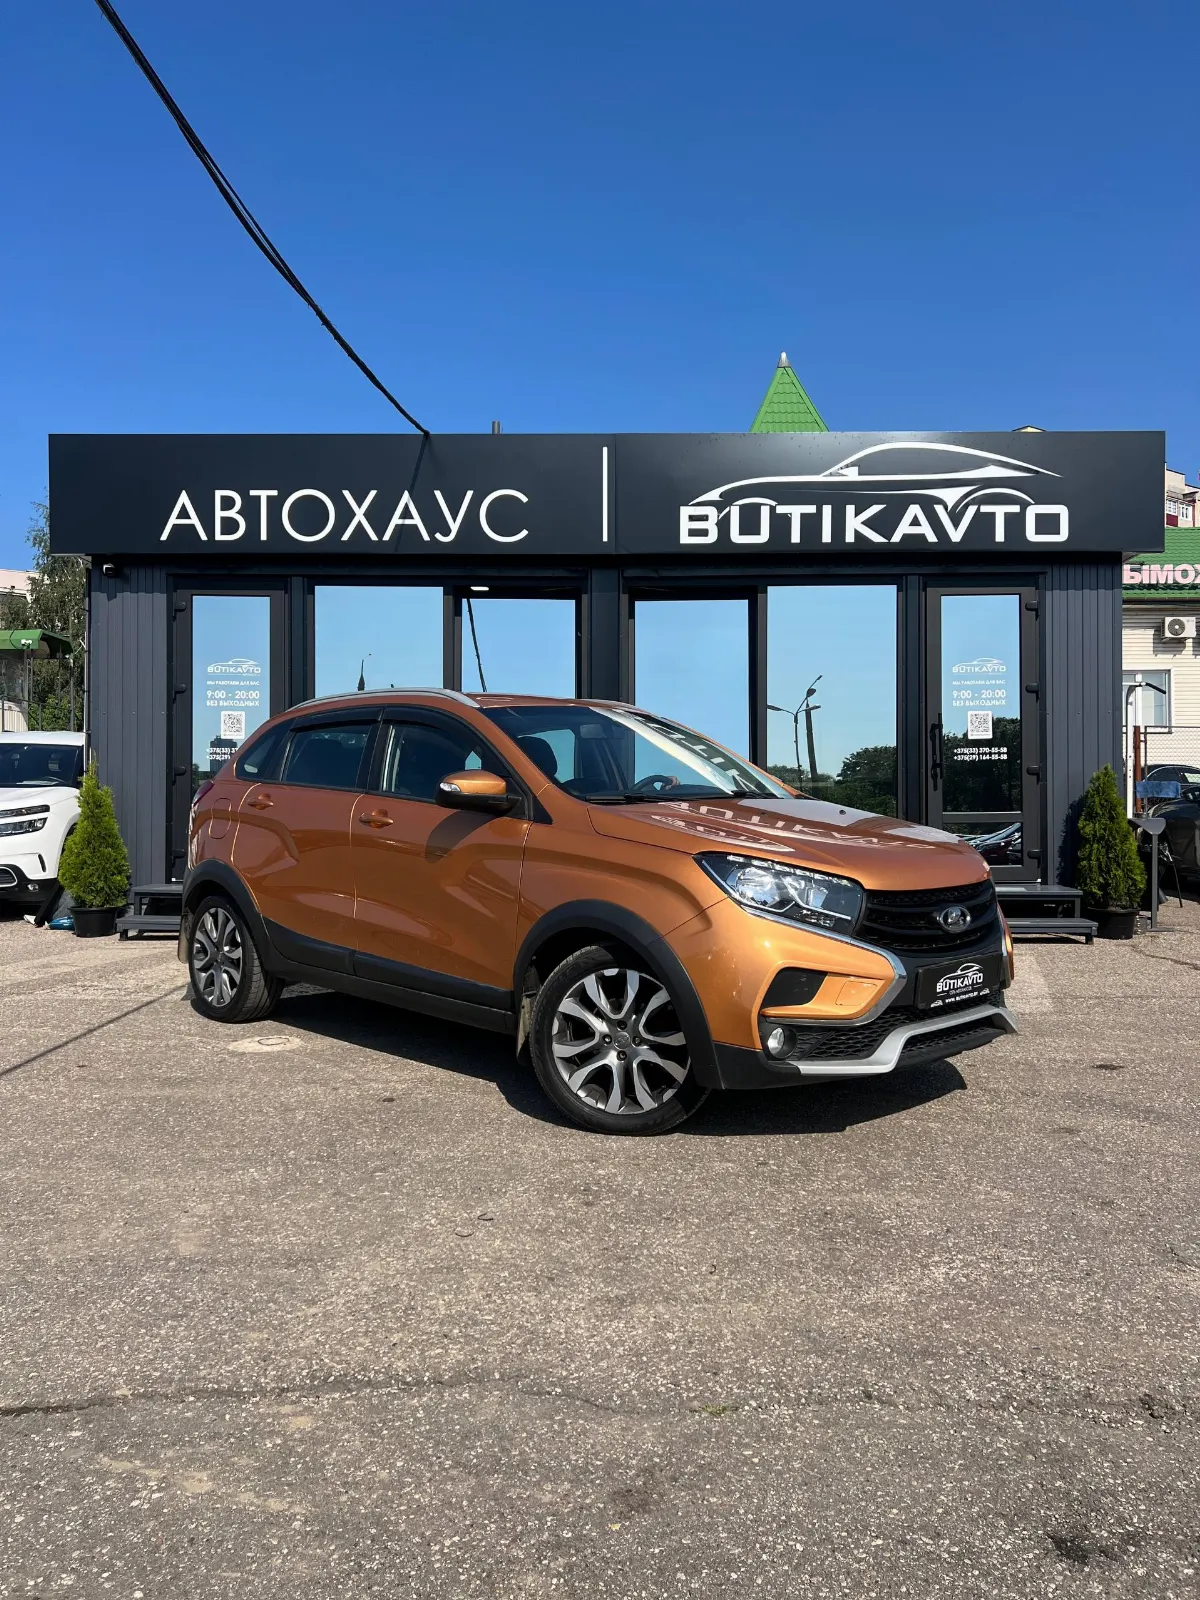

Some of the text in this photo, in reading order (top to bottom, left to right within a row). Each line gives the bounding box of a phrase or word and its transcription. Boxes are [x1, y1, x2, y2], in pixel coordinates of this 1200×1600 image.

[159, 488, 530, 543] АВТОХАУС
[679, 504, 1069, 544] BUTIKAVTO
[207, 665, 261, 674] BUTIKAVTO
[952, 665, 1006, 673] BUTIKAVTO
[206, 690, 226, 699] 9:00
[234, 690, 260, 699] 20:00
[952, 690, 972, 699] 9:00
[981, 689, 1006, 698] 20:00
[953, 747, 979, 755] +375(33)
[953, 754, 979, 762] +375(29)
[936, 973, 984, 992] BUTIKAVTO
